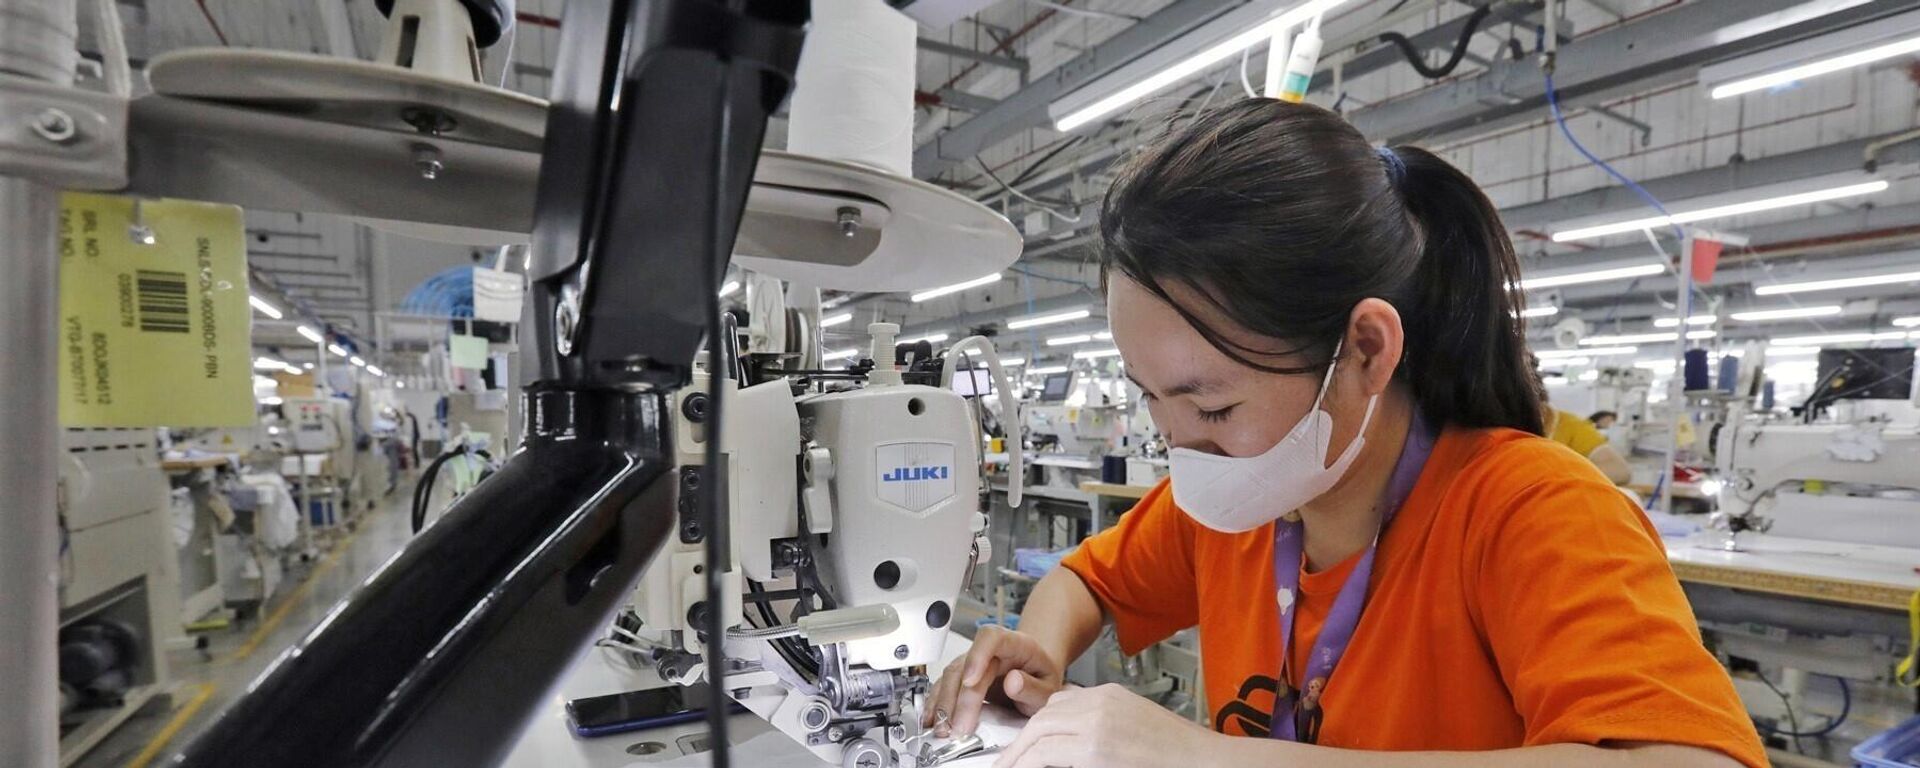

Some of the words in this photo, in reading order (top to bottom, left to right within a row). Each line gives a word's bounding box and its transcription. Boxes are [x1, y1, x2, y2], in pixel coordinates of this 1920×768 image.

[82, 210, 97, 233] SRL
[61, 238, 75, 257] NO
[85, 237, 99, 257] NO
[197, 238, 215, 351] SNLSDL-9000BDS-
[205, 354, 217, 378] PBN
[883, 466, 947, 481] JUKI
